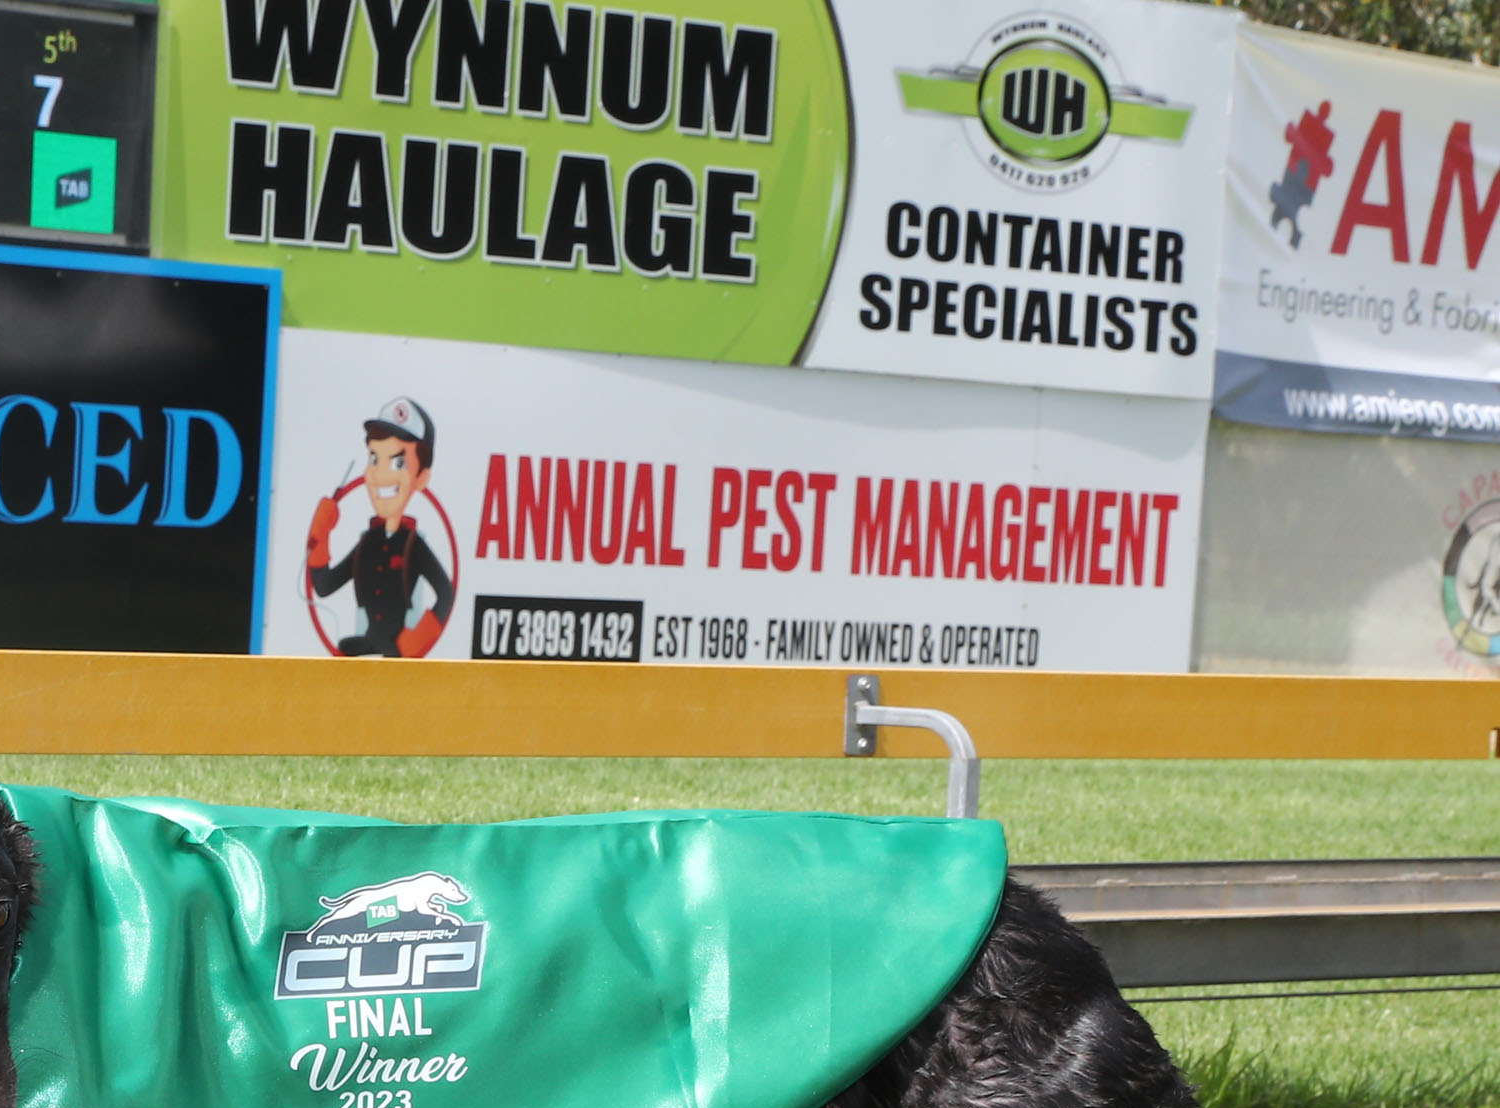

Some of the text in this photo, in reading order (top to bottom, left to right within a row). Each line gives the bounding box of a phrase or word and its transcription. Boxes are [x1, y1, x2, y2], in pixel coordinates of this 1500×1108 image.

[43, 30, 78, 64] 5th
[223, 0, 776, 142] WYNNUM
[33, 74, 63, 128] 7
[59, 178, 90, 199] TAB
[226, 118, 760, 285] HAULAGE
[886, 200, 1185, 285] CONTAINER
[859, 273, 1198, 357] SPECIALISTS
[1257, 267, 1395, 335] Engineering
[1403, 287, 1421, 326] &
[476, 452, 1180, 588] ANNUAL PEST MANAGEMENT
[653, 615, 692, 658] EST
[698, 616, 748, 660] 1968
[765, 618, 835, 662] FAMILY
[840, 621, 912, 665] OWNED
[918, 625, 934, 665] &
[940, 626, 1040, 667] OPERATED
[315, 928, 460, 946] ANNIVERSARY
[368, 902, 397, 920] TAB
[283, 940, 477, 992] CUP
[325, 996, 433, 1039] FINAL
[289, 1040, 469, 1092] Winner
